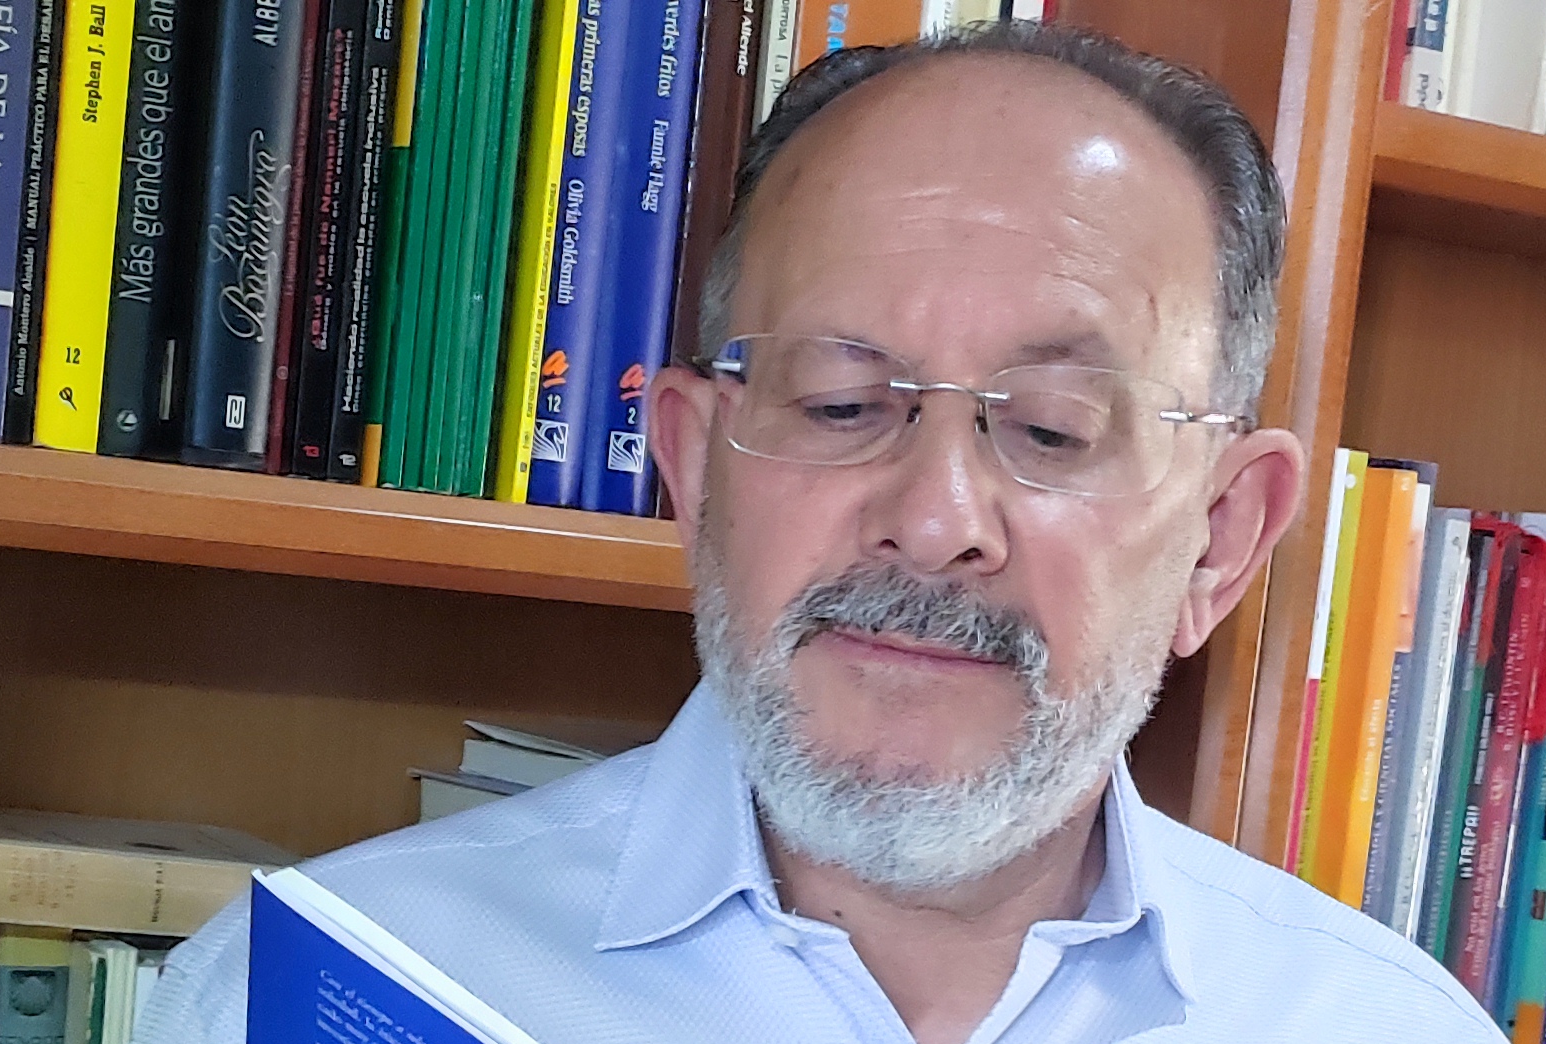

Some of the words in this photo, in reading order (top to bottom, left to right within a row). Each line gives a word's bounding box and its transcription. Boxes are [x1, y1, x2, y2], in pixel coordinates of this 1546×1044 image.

[86, 4, 107, 37] Ball
[38, 46, 54, 64] EL
[85, 43, 104, 55] J.
[138, 32, 174, 62] el
[572, 18, 602, 94] primeras
[34, 66, 52, 101] PARA
[79, 59, 105, 123] Stephen
[138, 67, 177, 123] que
[656, 54, 678, 98] fritos
[566, 95, 593, 157] esposas
[647, 119, 669, 169] Fannie
[24, 170, 42, 228] MANUAL
[122, 126, 173, 239] grandes
[561, 179, 585, 223] Olivia
[639, 171, 664, 213] Flagg
[207, 194, 250, 262] León
[116, 240, 156, 304] Más
[555, 227, 581, 305] Goldsmith
[64, 347, 81, 365] 12
[546, 395, 562, 413] 12
[626, 407, 637, 425] 2
